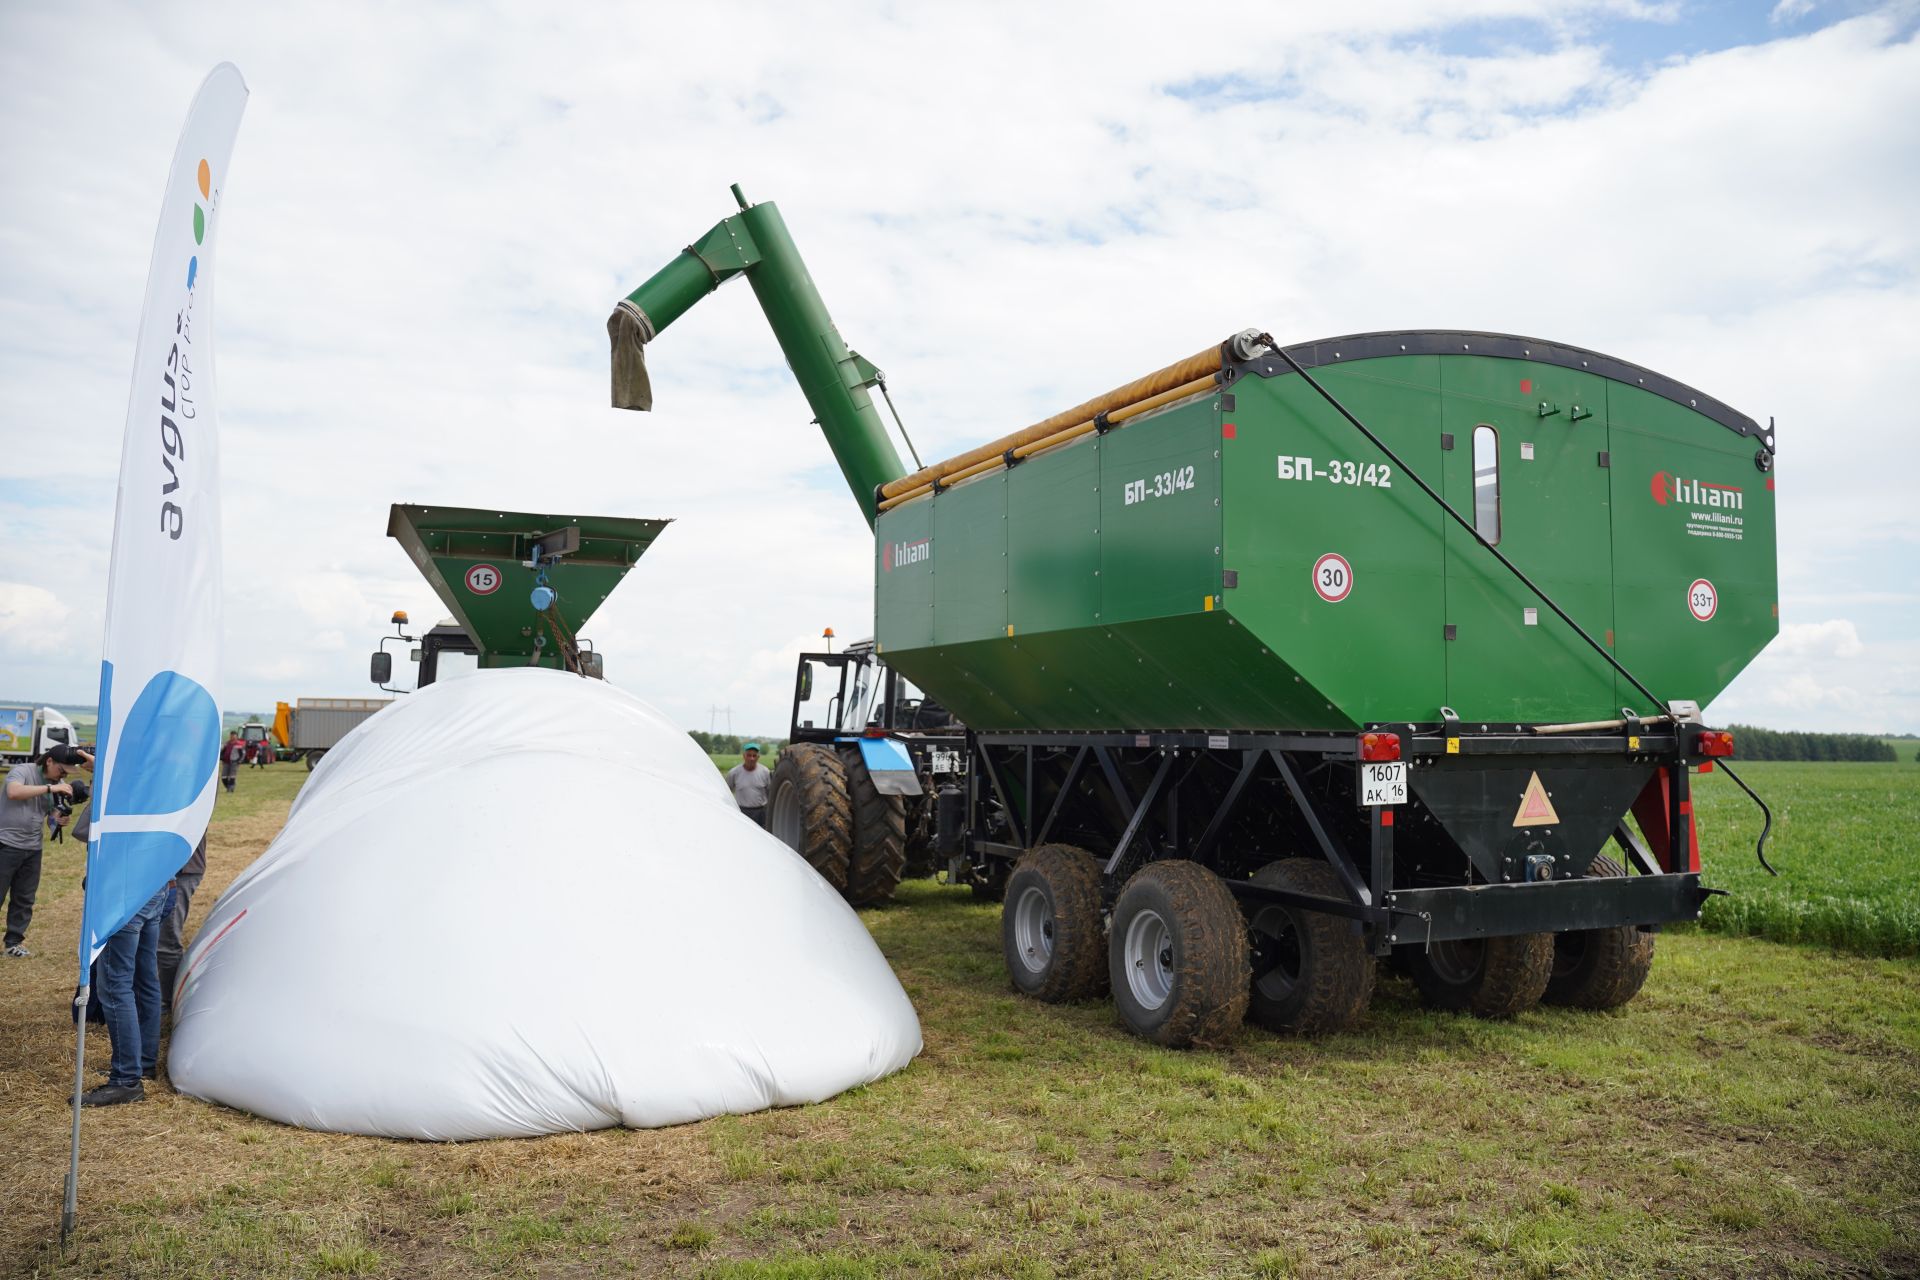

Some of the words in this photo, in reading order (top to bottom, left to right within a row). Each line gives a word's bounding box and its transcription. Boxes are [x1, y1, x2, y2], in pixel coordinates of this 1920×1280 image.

[181, 353, 196, 420] crop
[1277, 455, 1392, 488] БП-33/42
[1124, 465, 1195, 506] БП-33/42
[1676, 477, 1743, 509] liliani
[1690, 511, 1743, 525] www.liliani.ru
[895, 537, 930, 568] liliani
[473, 573, 494, 586] 15
[1322, 568, 1344, 588] 30
[1692, 593, 1713, 607] 33т
[1369, 764, 1401, 782] 1607
[1391, 784, 1403, 796] 16
